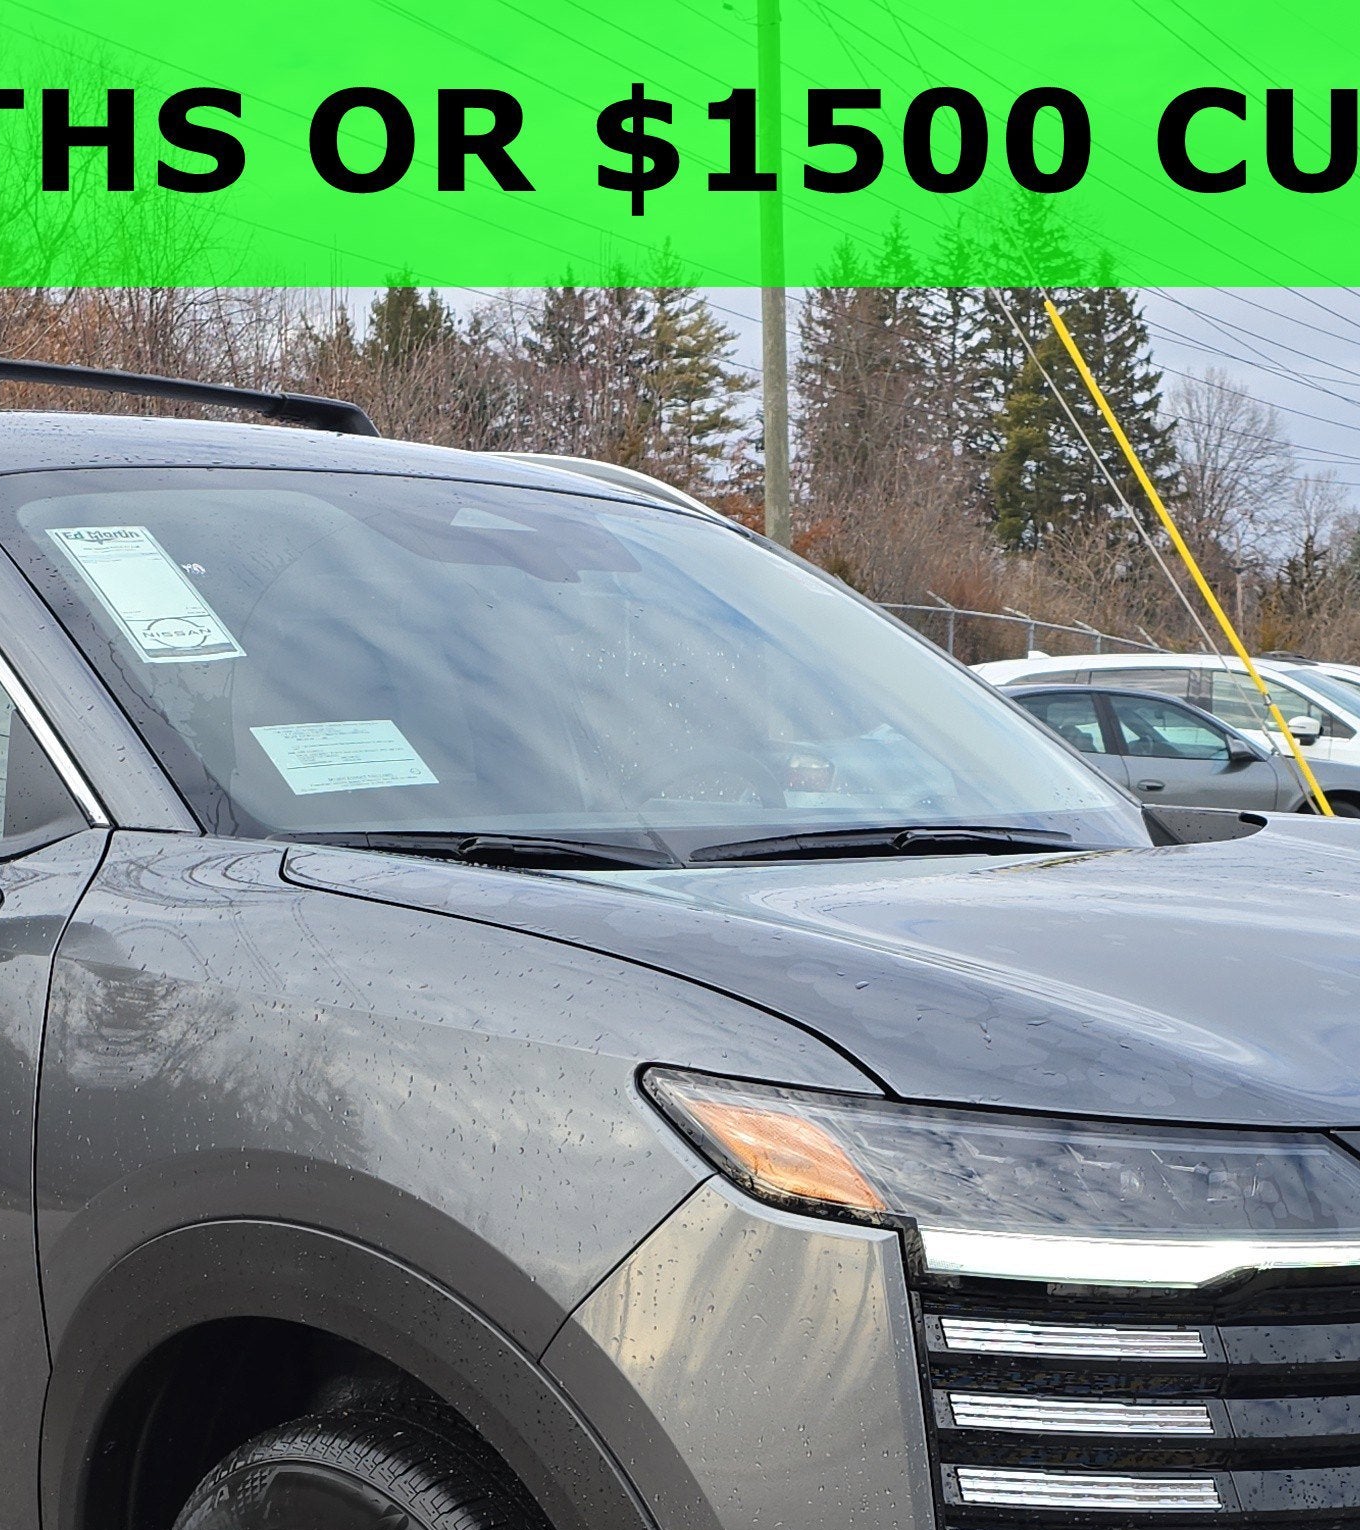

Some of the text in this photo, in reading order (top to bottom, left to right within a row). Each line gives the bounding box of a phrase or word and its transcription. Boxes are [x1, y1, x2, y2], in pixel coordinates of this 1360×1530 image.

[62, 529, 140, 541] Ed Martin
[142, 627, 212, 639] NISSAN
